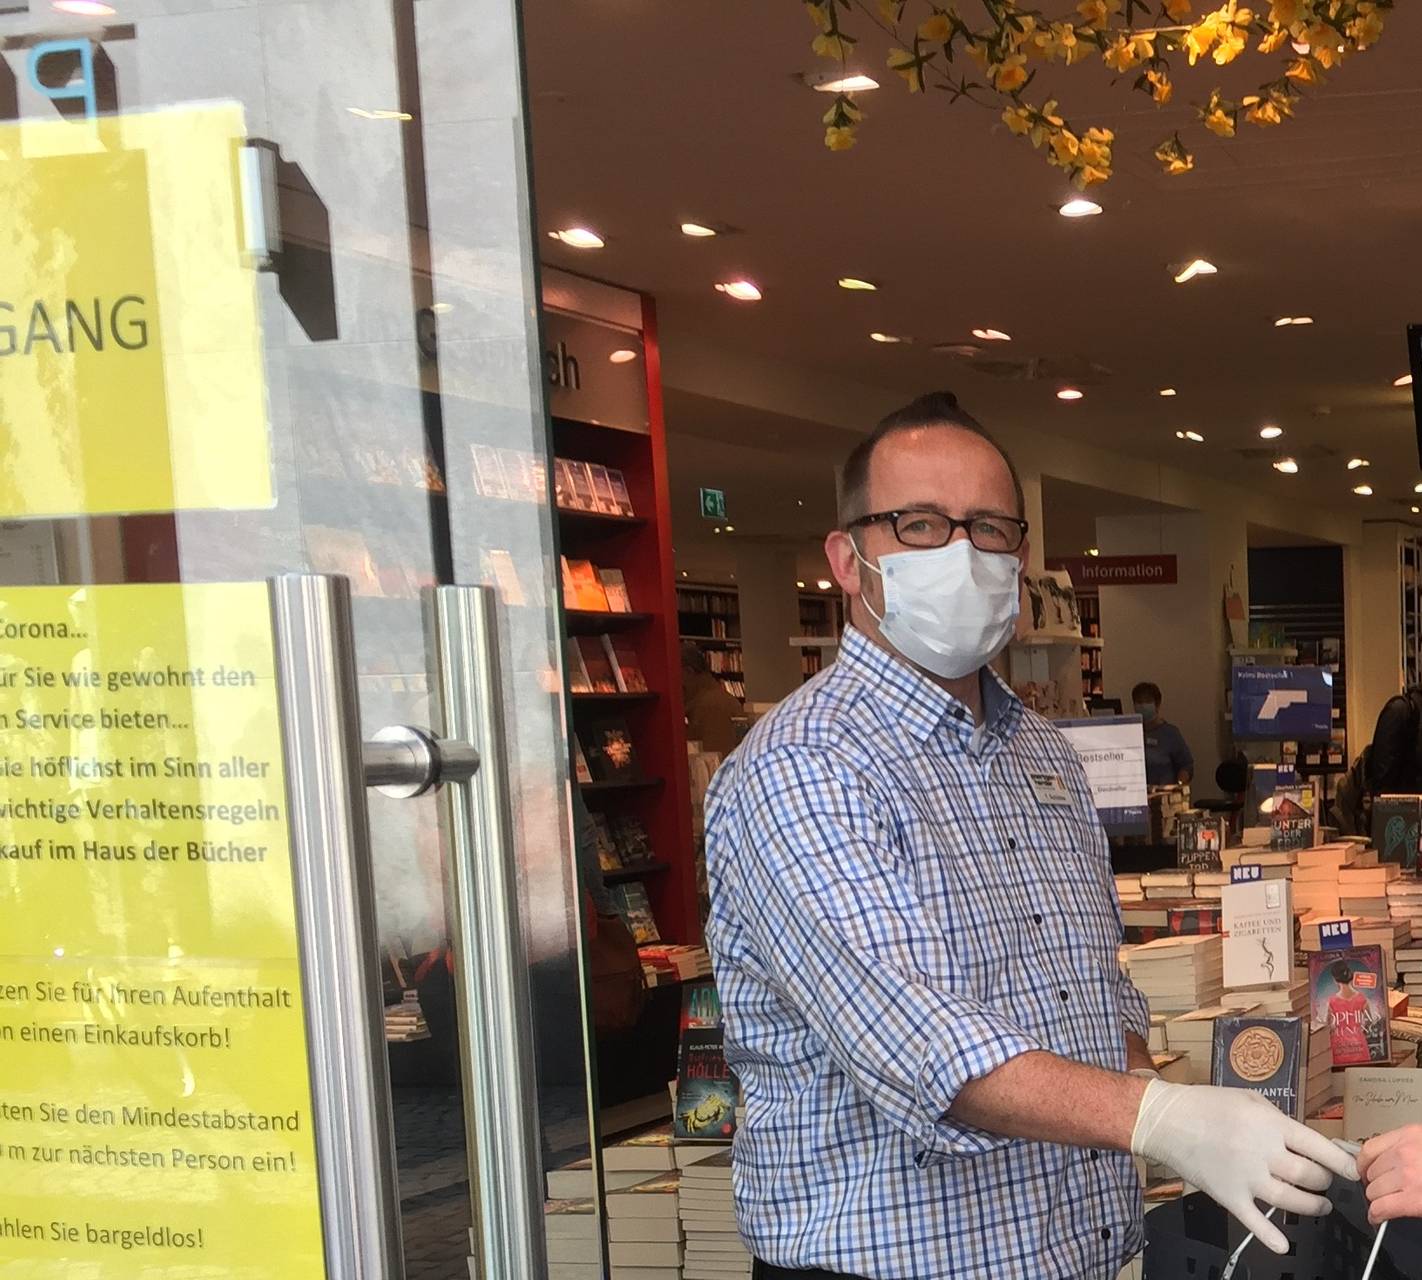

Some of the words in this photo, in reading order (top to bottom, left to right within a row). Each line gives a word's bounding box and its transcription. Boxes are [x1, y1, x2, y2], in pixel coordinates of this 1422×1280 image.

[1081, 564, 1163, 578] Information
[0, 619, 88, 639] orona...
[25, 667, 55, 688] Sie
[62, 668, 100, 687] wie
[107, 665, 205, 692] gewohnt
[212, 665, 255, 687] den
[16, 709, 95, 729] Service
[100, 708, 189, 729] bieten...
[0, 757, 23, 778] ie
[31, 756, 123, 778] höflichst
[130, 757, 156, 777] im
[163, 757, 212, 778] Sinn
[219, 756, 269, 778] aller
[86, 798, 280, 825] Verhaltensregeln
[1274, 819, 1312, 830] UNTER
[49, 840, 76, 860] im
[84, 840, 136, 861] Haus
[143, 840, 180, 861] der
[187, 840, 268, 862] Bücher
[1181, 852, 1218, 864] PUPPEN
[1233, 867, 1259, 880] NEU
[1322, 922, 1349, 937] NEU
[36, 981, 66, 1002] Sie
[72, 982, 101, 1003] für
[110, 982, 165, 1006] Ihren
[172, 985, 292, 1009] Aufenthalt
[20, 1023, 76, 1043] einen
[84, 1023, 231, 1049] Einkaufskorb!
[39, 1103, 69, 1123] Sie
[75, 1104, 115, 1126] den
[121, 1106, 299, 1132] Mindestabstand
[32, 1146, 62, 1162] zur
[69, 1145, 165, 1168] nächsten
[172, 1148, 244, 1171] Person
[252, 1151, 297, 1172] ein!
[50, 1221, 79, 1242] Sie
[86, 1223, 204, 1250] bargeldlos!
